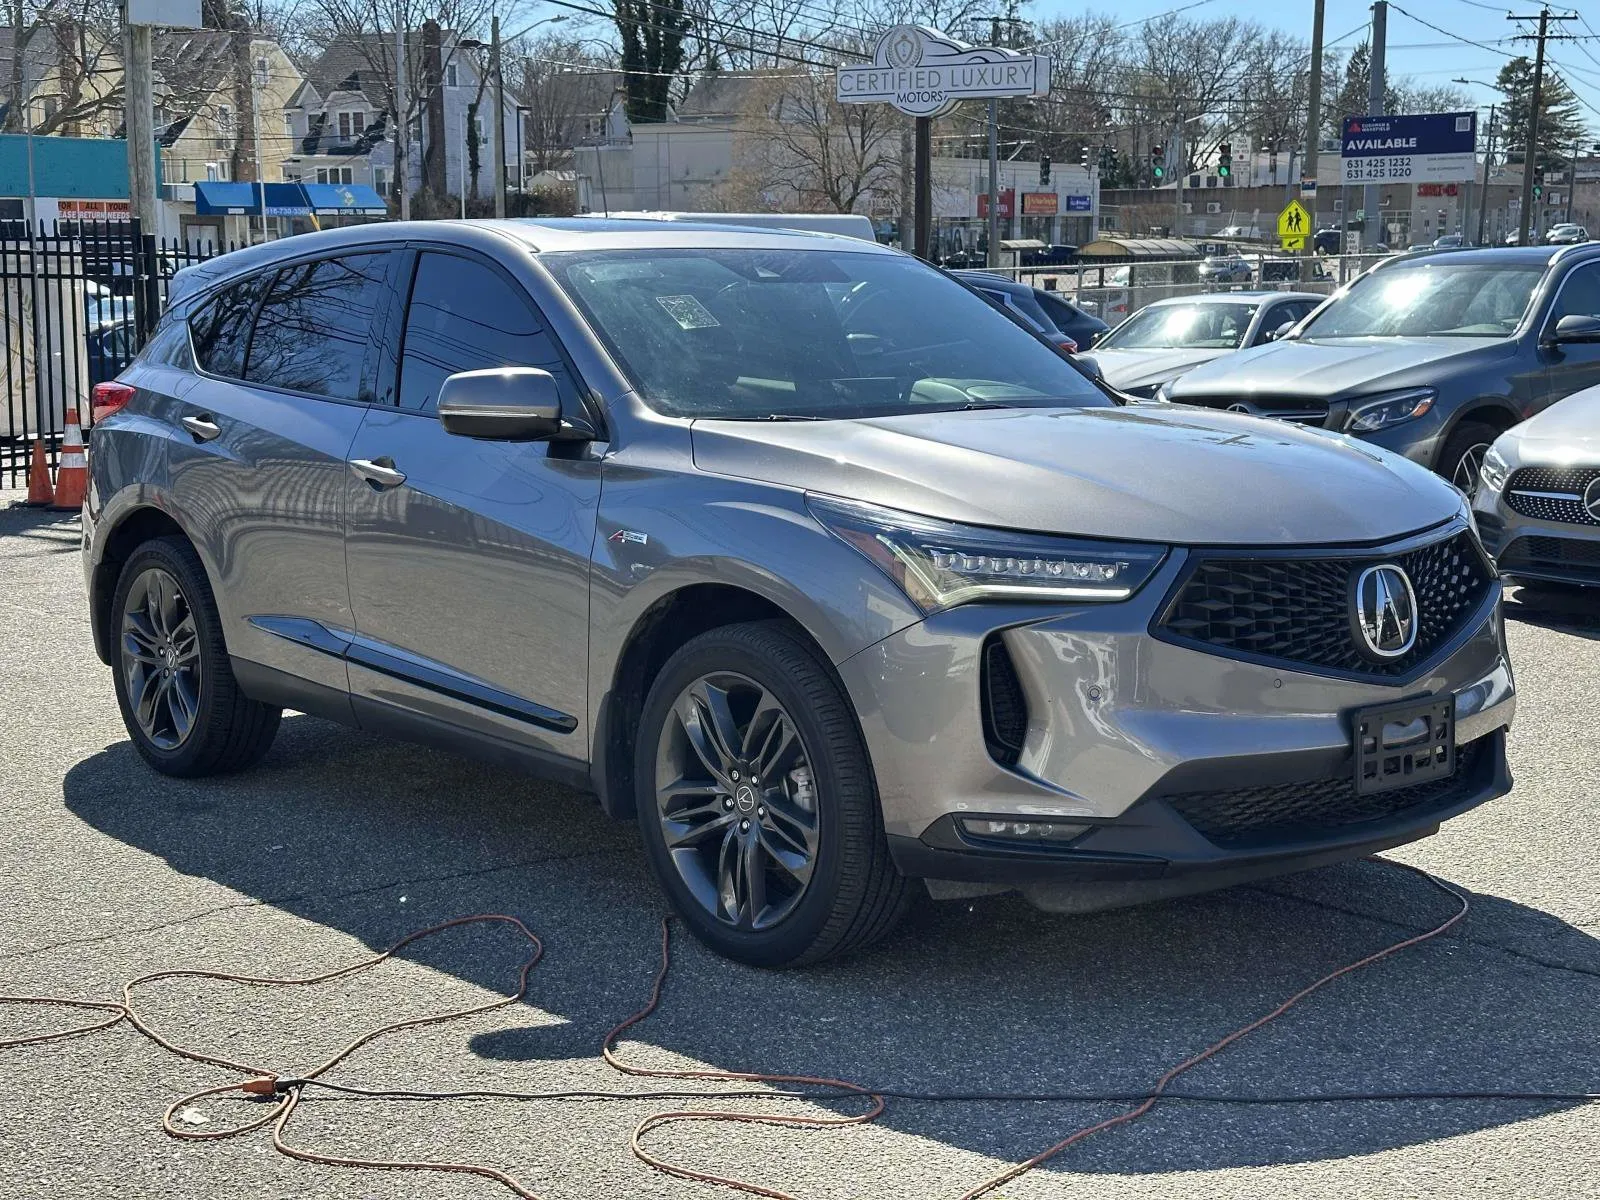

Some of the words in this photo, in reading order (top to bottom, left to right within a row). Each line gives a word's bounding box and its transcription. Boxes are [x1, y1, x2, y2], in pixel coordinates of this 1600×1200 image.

[839, 71, 941, 92] CERTIFIED
[950, 65, 1032, 88] LUXURY
[896, 91, 944, 104] MOTORS
[1347, 138, 1417, 151] AVAILABLE
[1347, 160, 1363, 168] 631
[1366, 159, 1385, 168] 425
[1389, 157, 1411, 166] 1232
[1347, 170, 1363, 179] 631
[1366, 169, 1385, 178] 425
[1389, 168, 1412, 177] 1220
[85, 202, 98, 210] ALL
[109, 202, 128, 211] YOUR
[79, 211, 105, 220] RETURN
[107, 211, 130, 220] NEEDS
